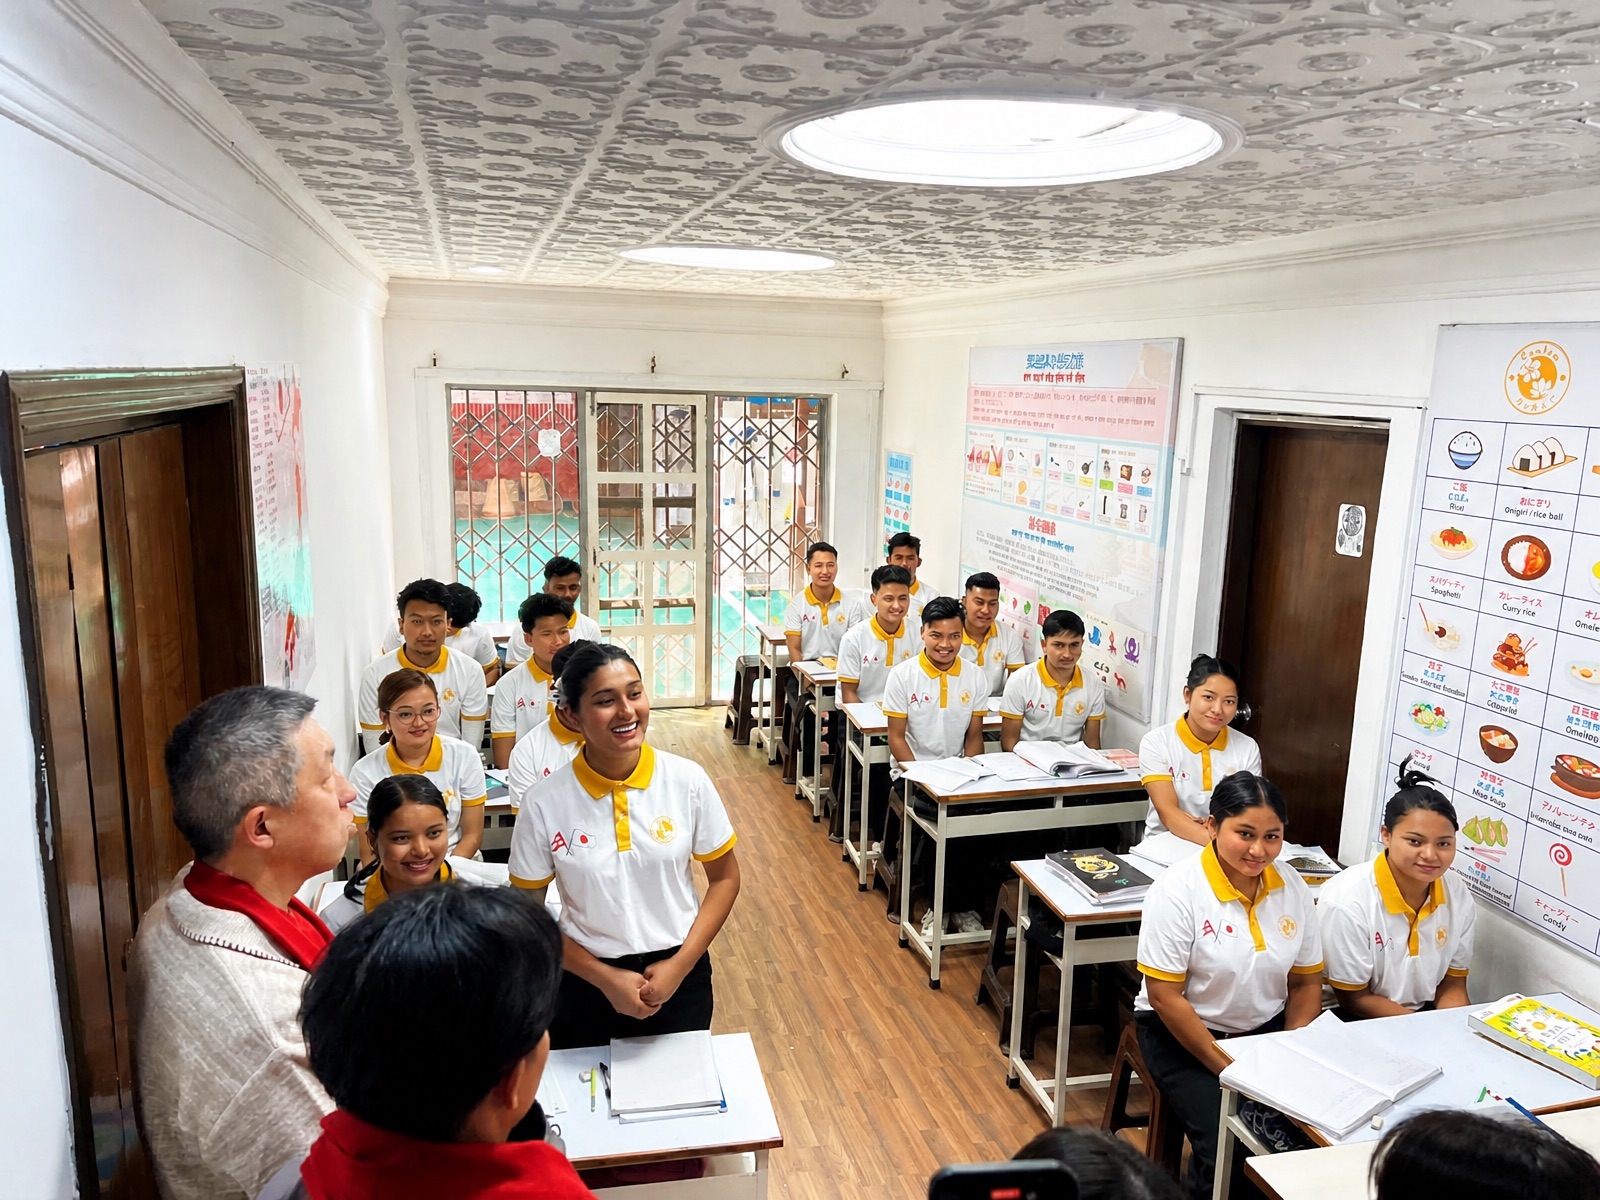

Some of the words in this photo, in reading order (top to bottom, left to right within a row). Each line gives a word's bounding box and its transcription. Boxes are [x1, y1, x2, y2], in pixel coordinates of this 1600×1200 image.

[1499, 591, 1542, 607] カレーライス
[1502, 603, 1521, 615] Curry
[1523, 608, 1536, 617] rice
